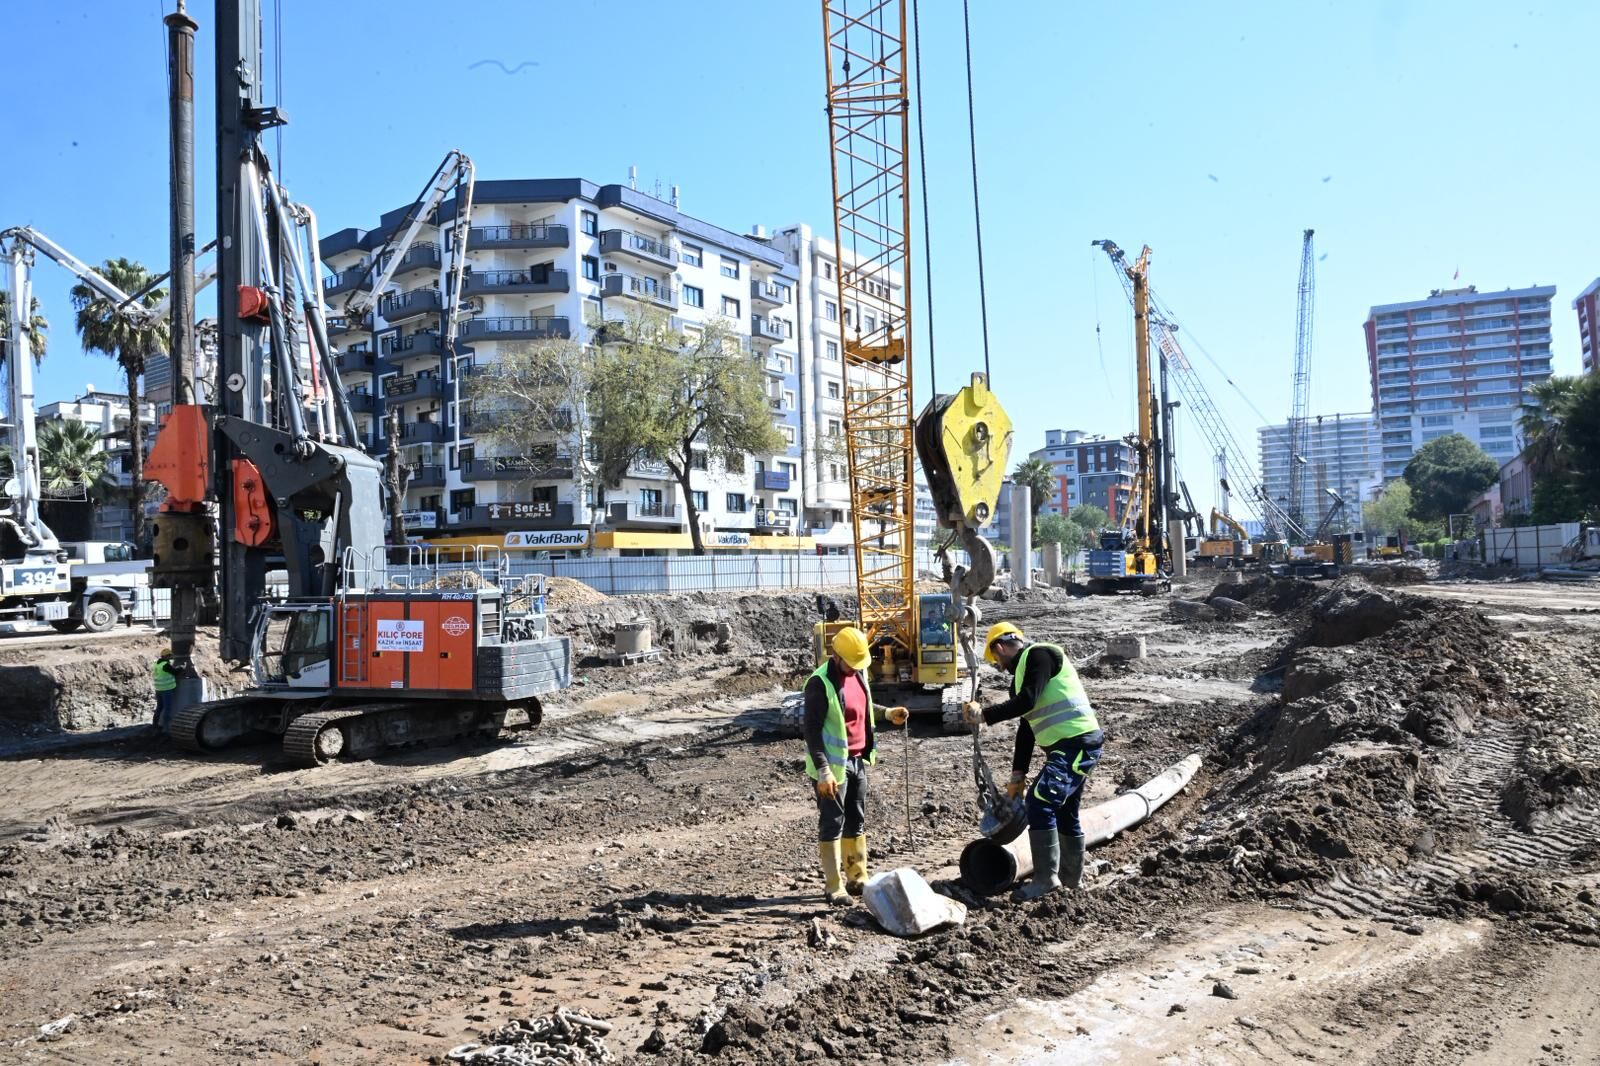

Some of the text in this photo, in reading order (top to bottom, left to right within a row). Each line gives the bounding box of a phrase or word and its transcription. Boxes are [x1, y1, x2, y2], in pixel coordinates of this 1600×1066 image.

[514, 503, 552, 513] Ser-EL
[525, 533, 584, 545] VakıfBank
[378, 631, 423, 640] KILIÇ FORE
